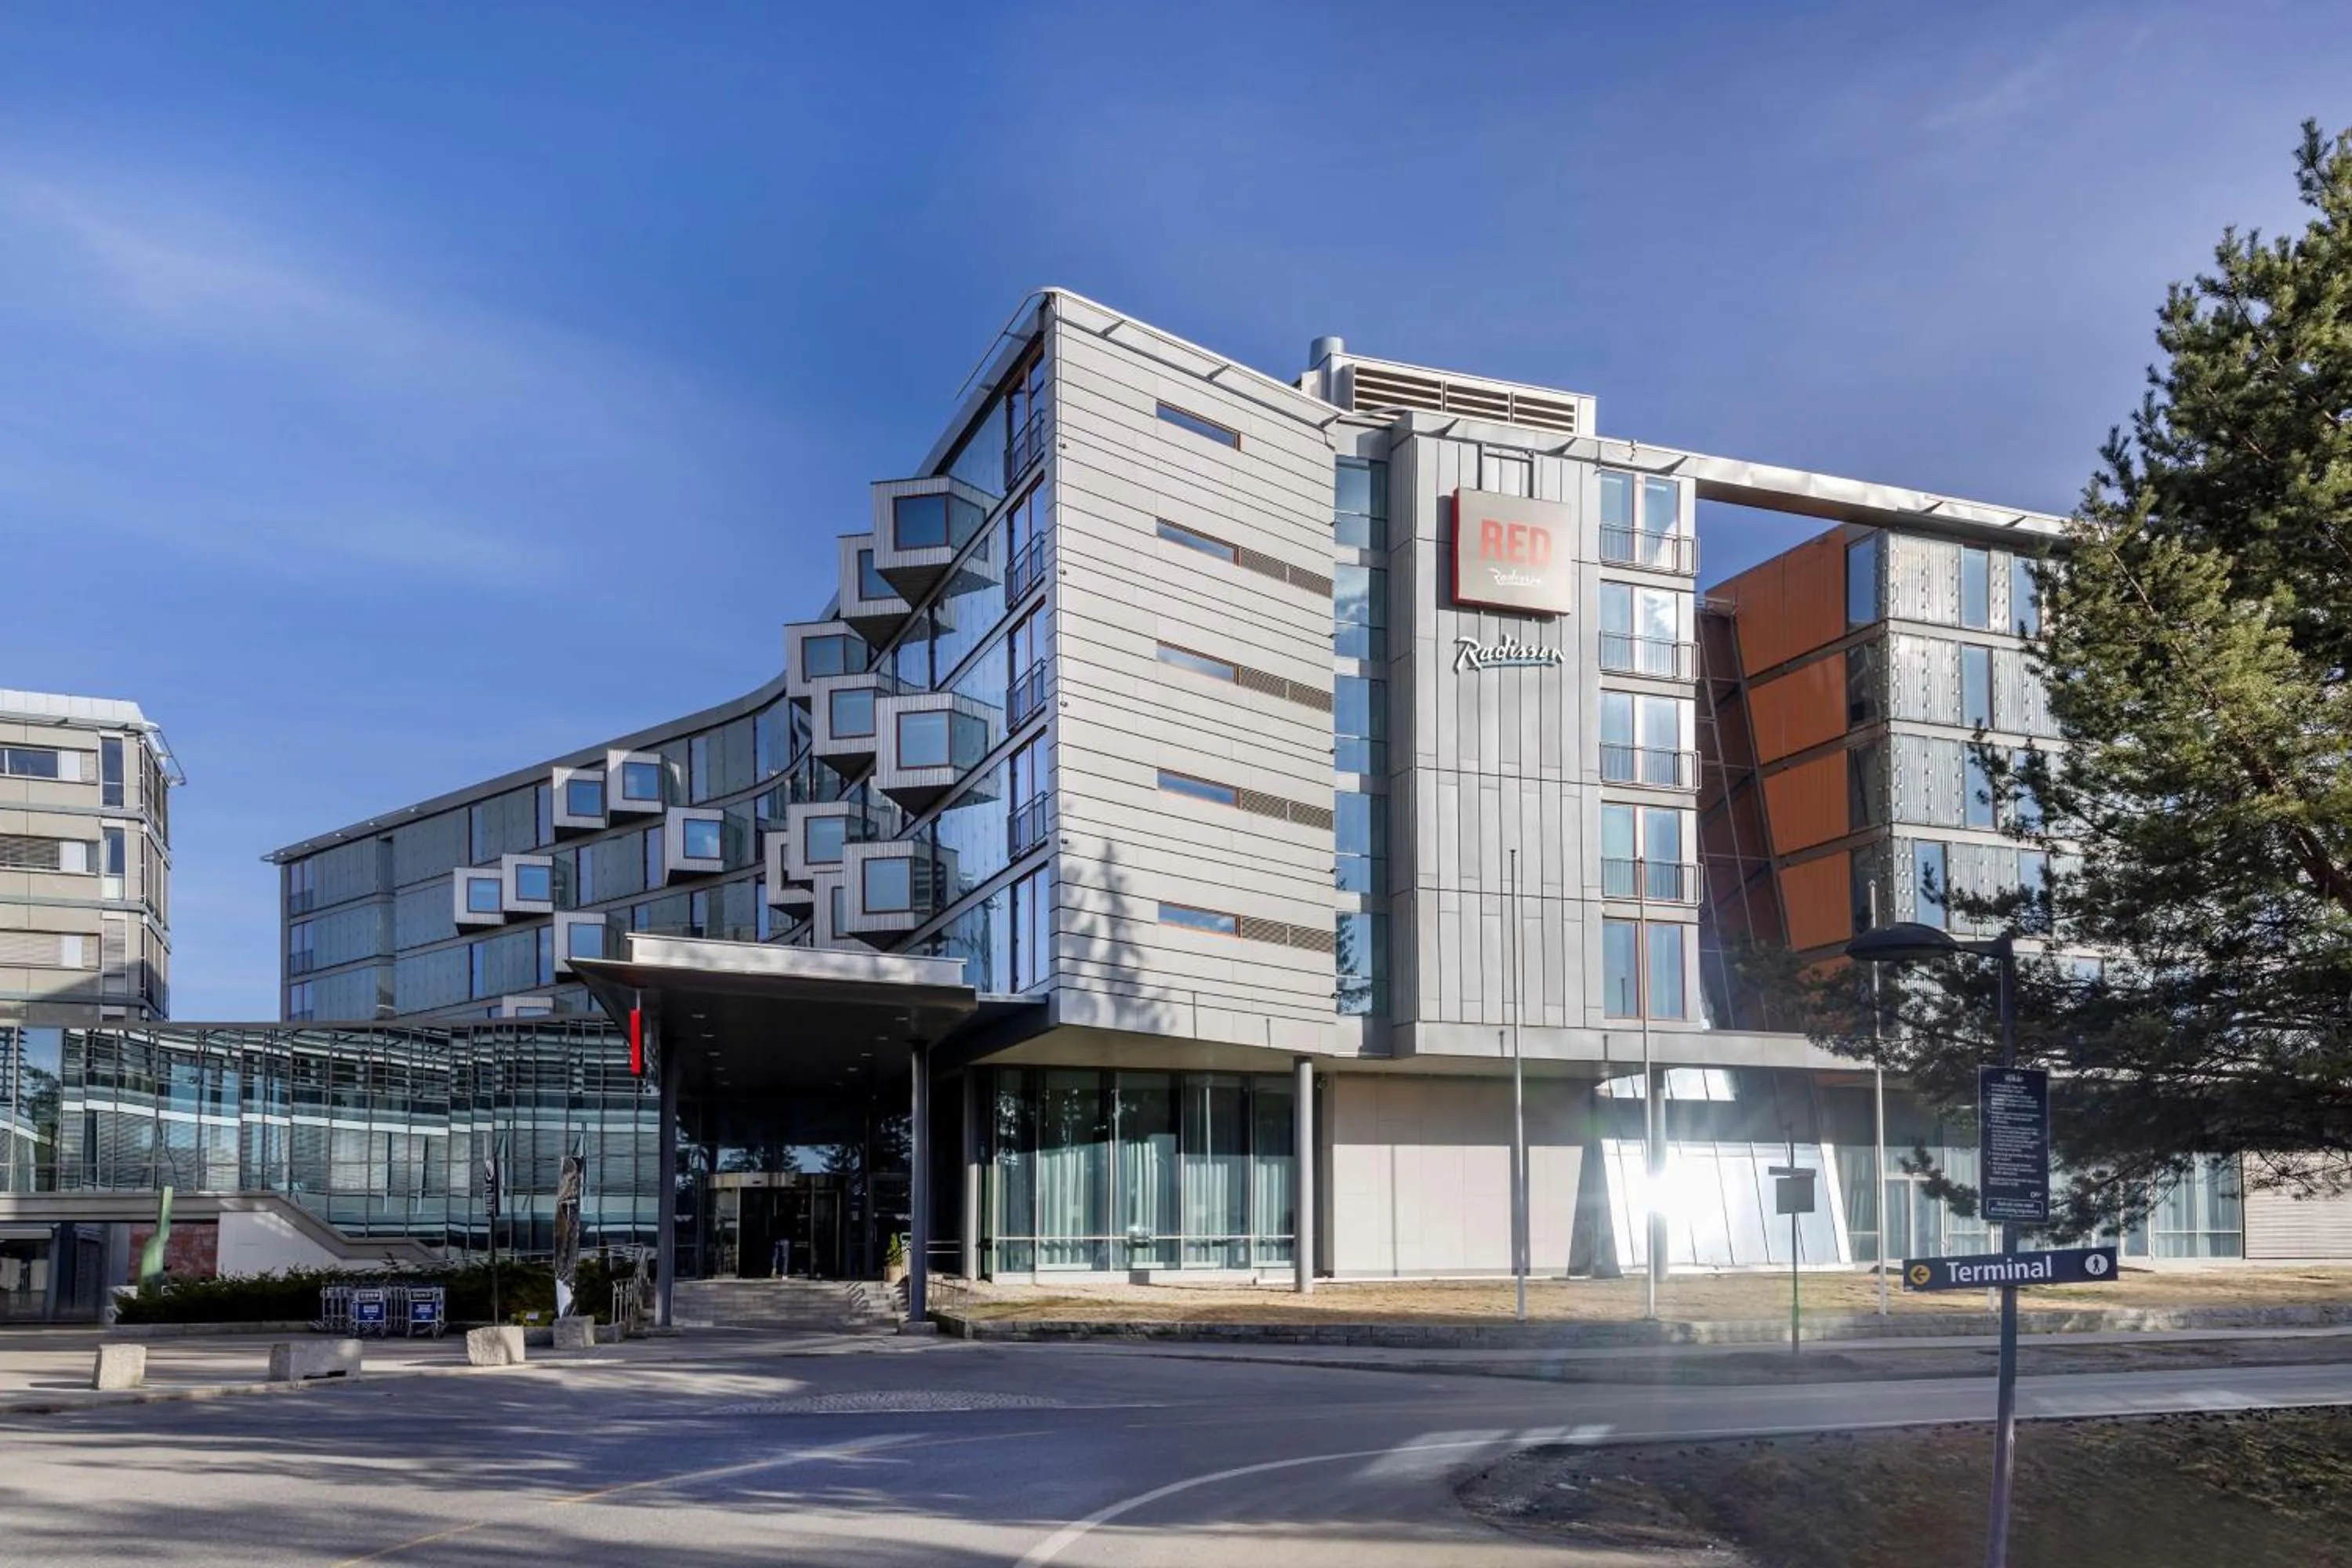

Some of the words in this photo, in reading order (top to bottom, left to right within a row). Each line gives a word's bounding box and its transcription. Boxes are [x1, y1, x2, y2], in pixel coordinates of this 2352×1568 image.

[1480, 518, 1552, 564] RED
[1453, 634, 1566, 674] Radisson
[1946, 1255, 2053, 1283] Terminal
